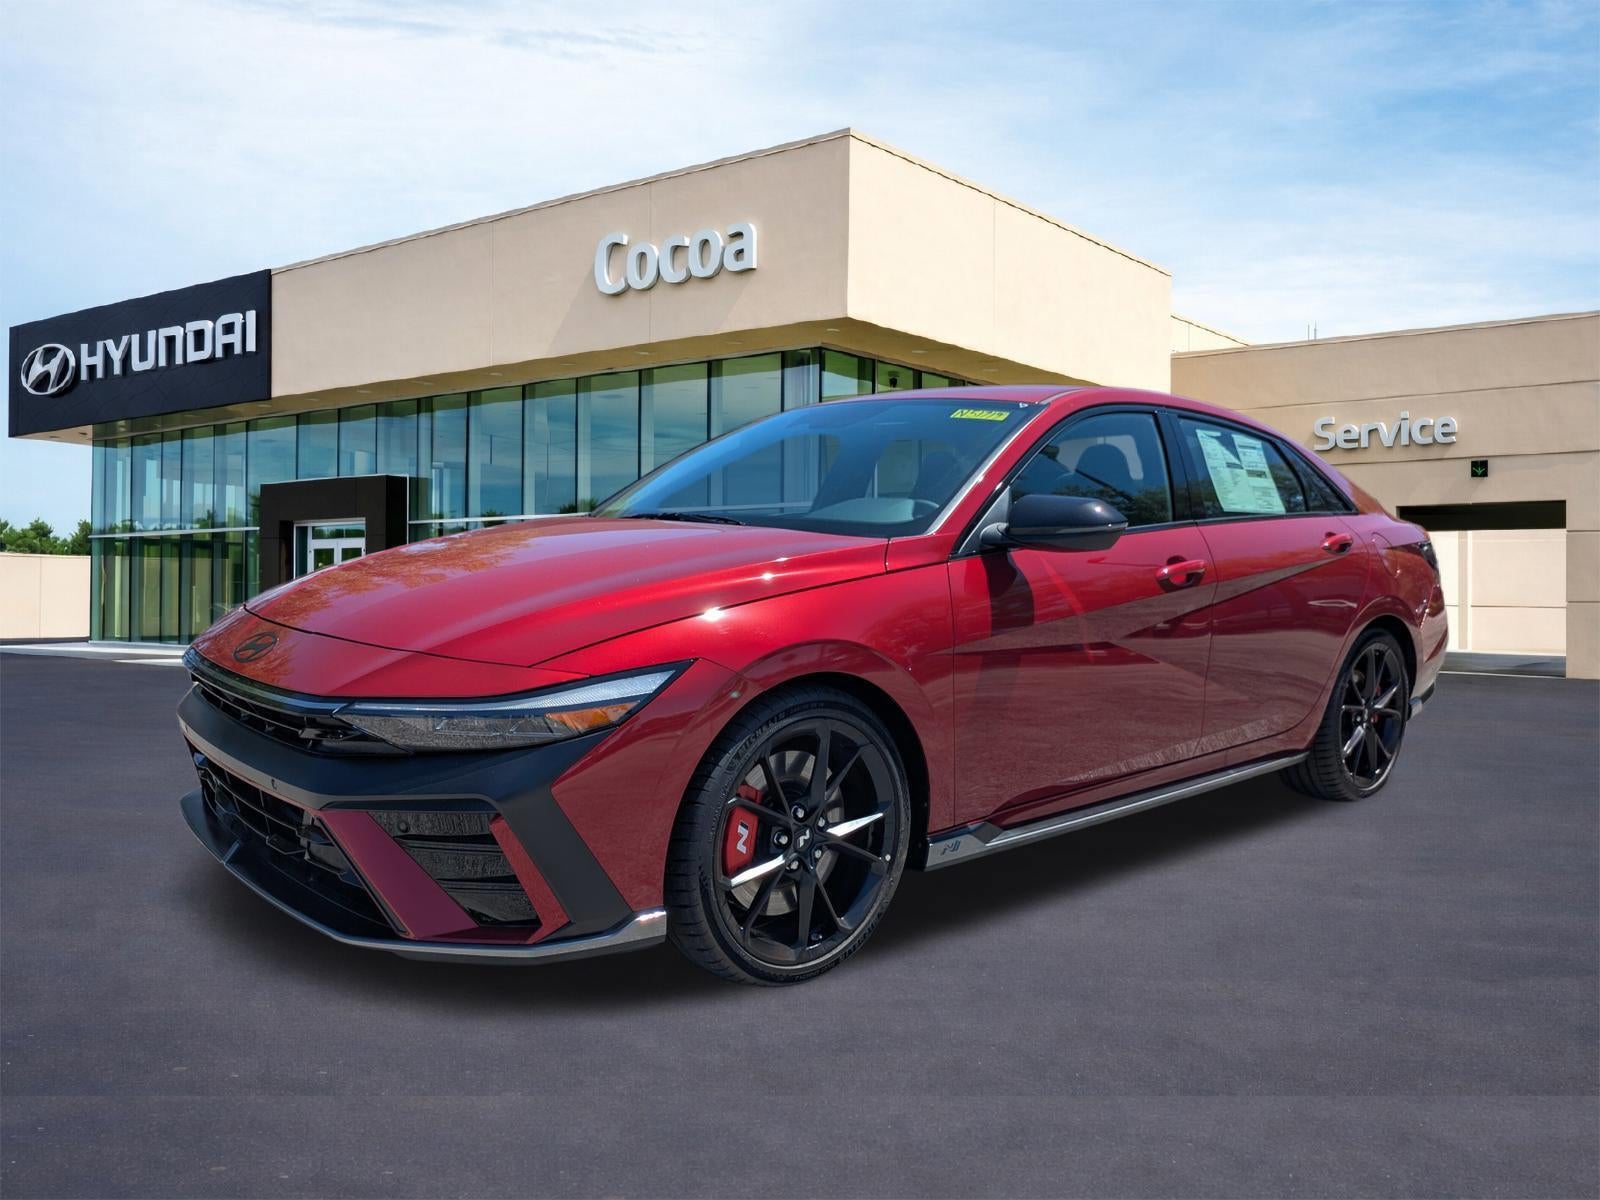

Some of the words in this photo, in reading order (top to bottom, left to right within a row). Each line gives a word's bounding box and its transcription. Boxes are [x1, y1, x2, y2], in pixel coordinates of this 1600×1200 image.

[594, 222, 758, 295] Cocoa
[80, 310, 257, 382] HYUNDAI
[1313, 410, 1458, 451] Service
